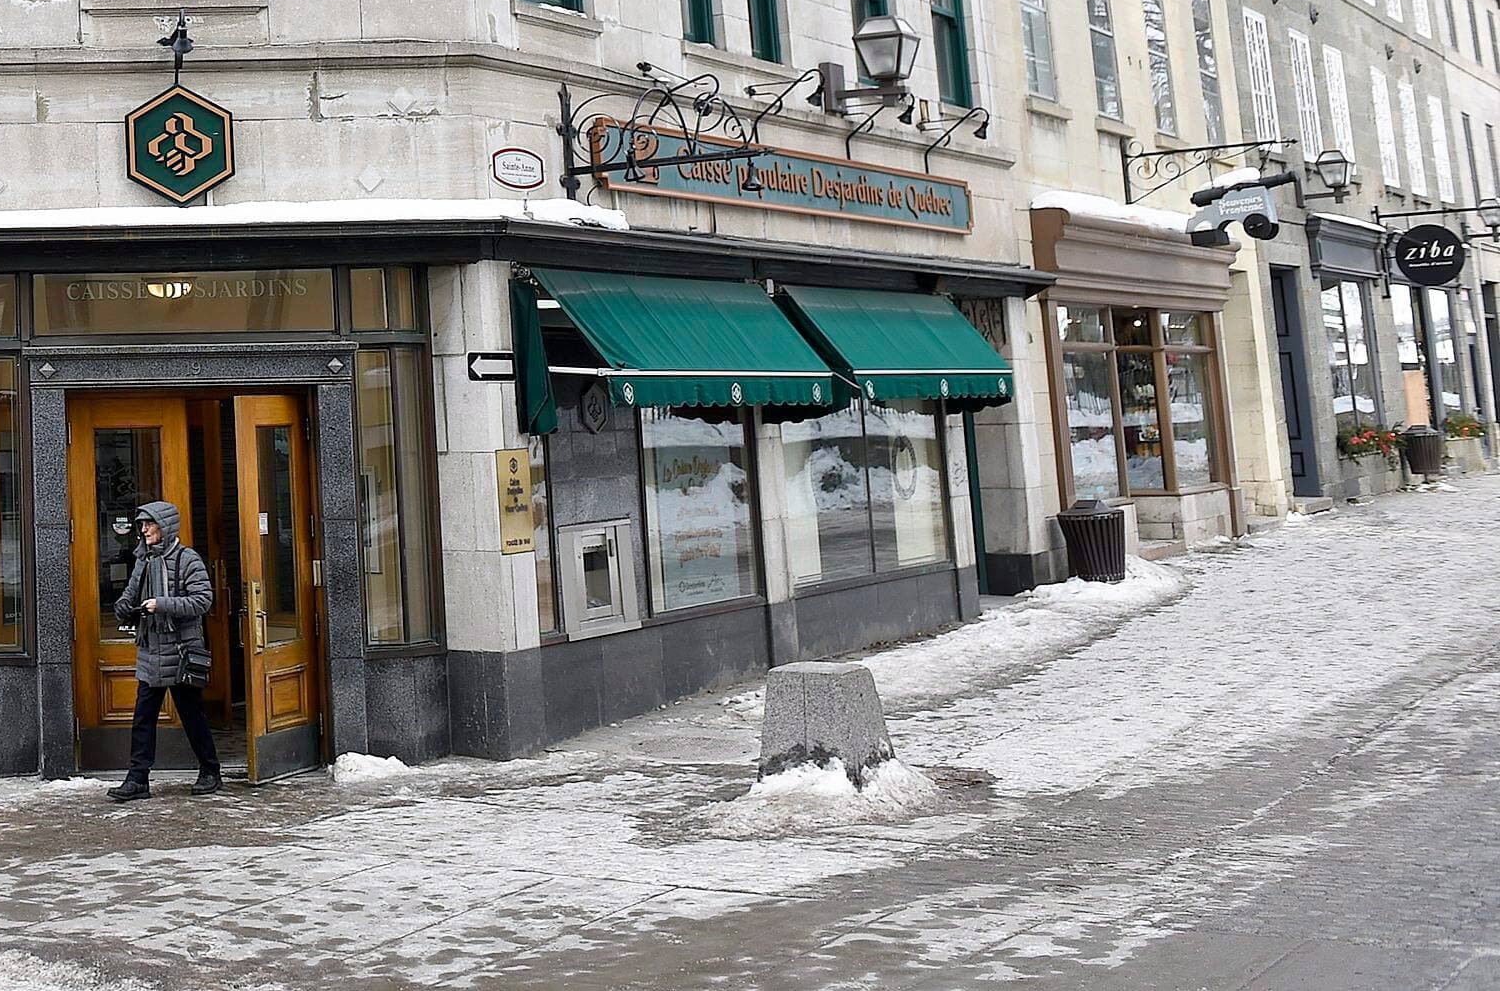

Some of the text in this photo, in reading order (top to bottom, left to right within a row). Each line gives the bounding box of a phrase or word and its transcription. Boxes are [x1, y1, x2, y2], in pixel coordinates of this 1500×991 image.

[676, 146, 952, 219] Caisse ppulaire Desjardins de Québec
[1404, 240, 1455, 260] ziba
[66, 278, 308, 301] CAISSE DESJARDINS
